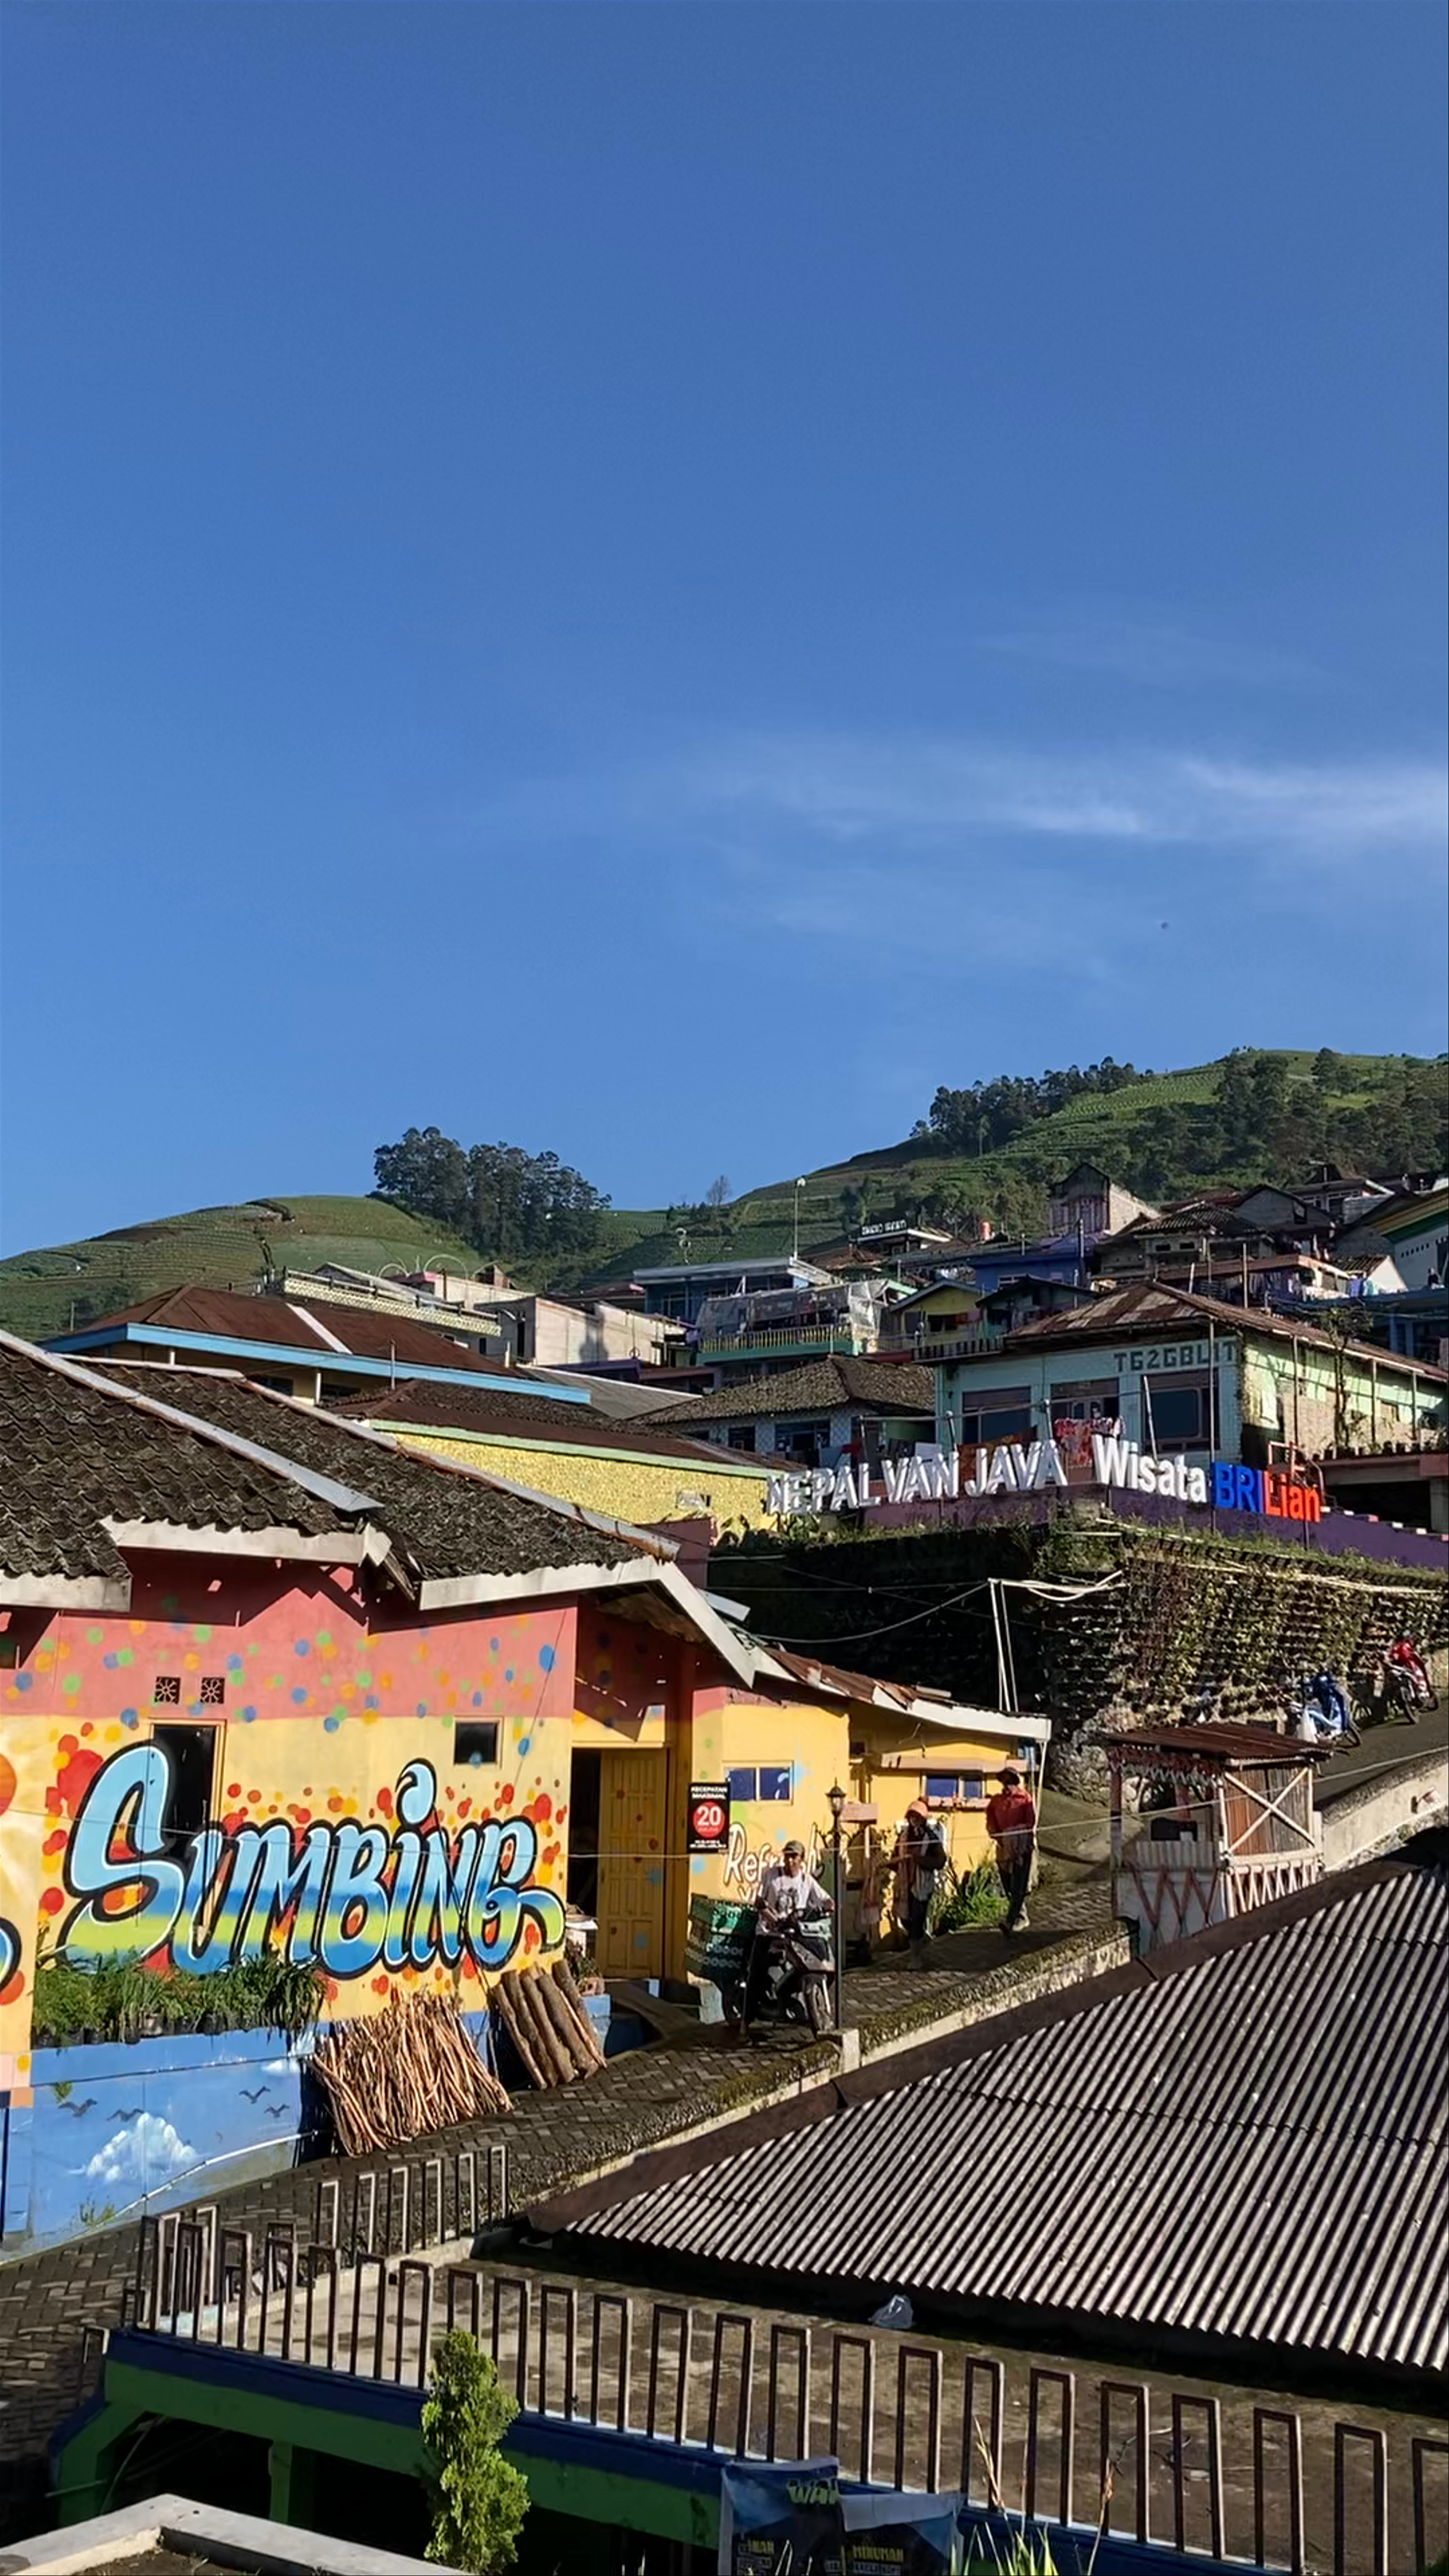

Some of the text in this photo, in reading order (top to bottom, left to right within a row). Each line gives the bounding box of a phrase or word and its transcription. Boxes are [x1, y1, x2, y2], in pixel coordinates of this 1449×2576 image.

[766, 1438, 1068, 1514] NEPAL VAN JAVA
[1091, 1433, 1207, 1504] Wisata
[698, 1805, 721, 1826] 20
